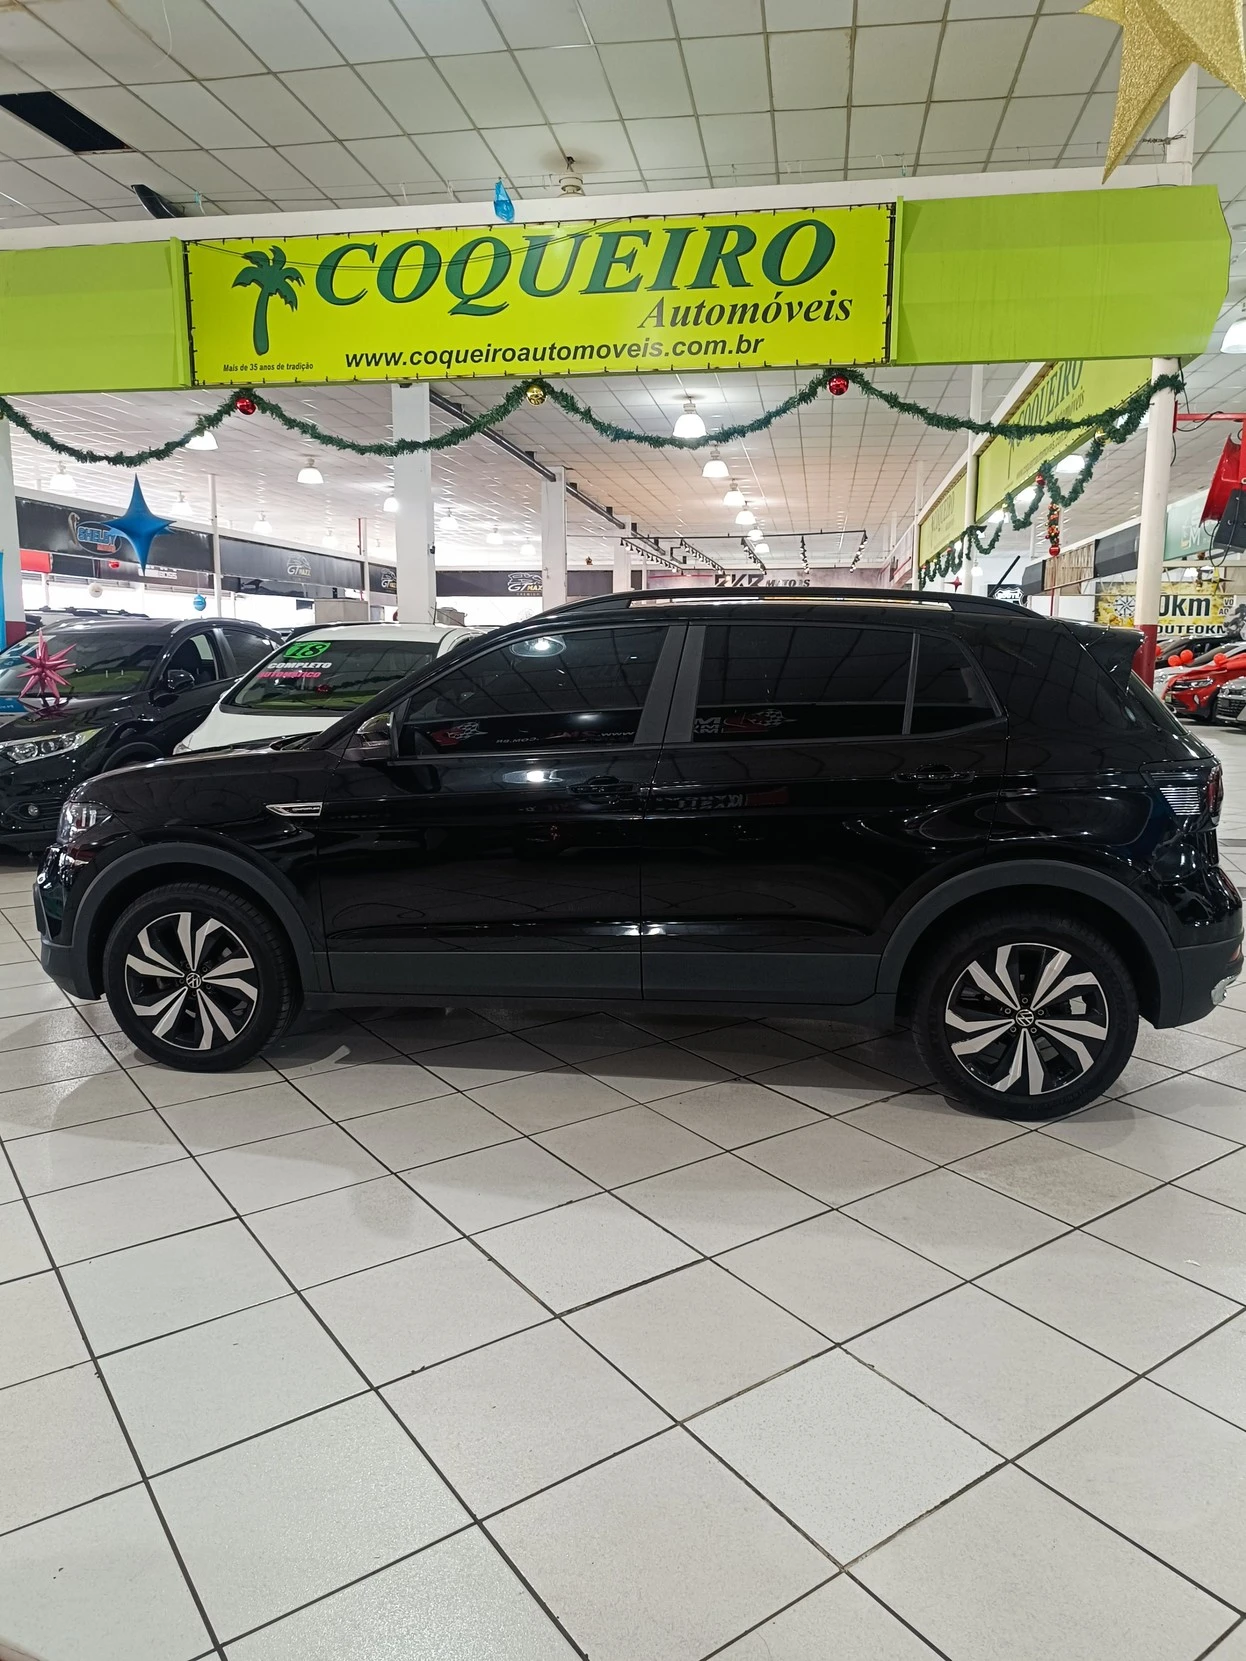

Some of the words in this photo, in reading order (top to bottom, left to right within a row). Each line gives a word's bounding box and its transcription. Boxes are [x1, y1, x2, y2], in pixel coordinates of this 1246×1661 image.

[315, 219, 836, 317] COQUEIRO
[637, 289, 853, 329] Automóveis
[223, 364, 239, 372] Mais
[240, 363, 249, 372] de
[249, 363, 258, 371] 35
[259, 363, 275, 371] anos
[276, 362, 285, 370] de
[286, 361, 314, 372] tradição
[345, 334, 765, 371] www.coqueiroautomoveis.com.br
[289, 643, 326, 657] 18
